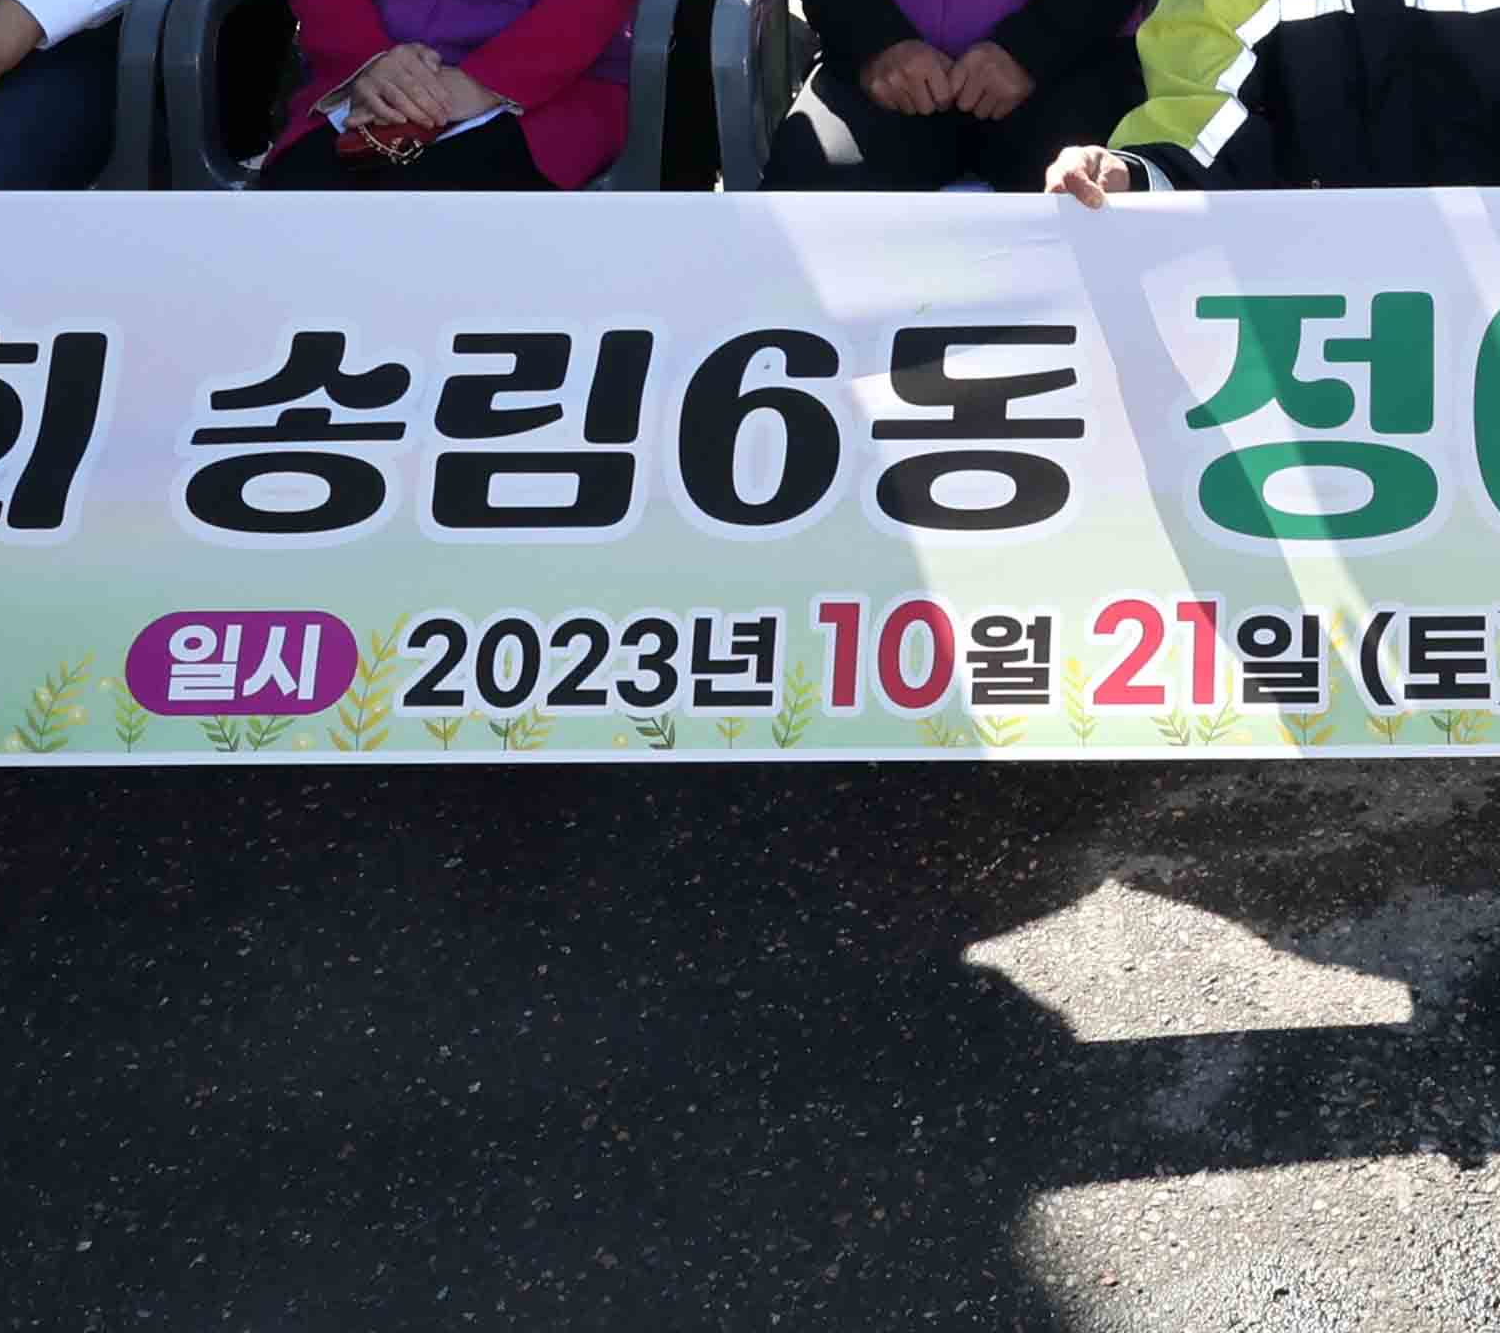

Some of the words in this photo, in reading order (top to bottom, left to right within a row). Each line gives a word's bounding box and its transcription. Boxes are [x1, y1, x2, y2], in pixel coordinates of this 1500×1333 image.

[186, 326, 1084, 533] 송림6동
[166, 623, 321, 703] 일시
[404, 615, 777, 707] 2023년
[814, 601, 1054, 707] 10월
[1093, 598, 1322, 707] 21일
